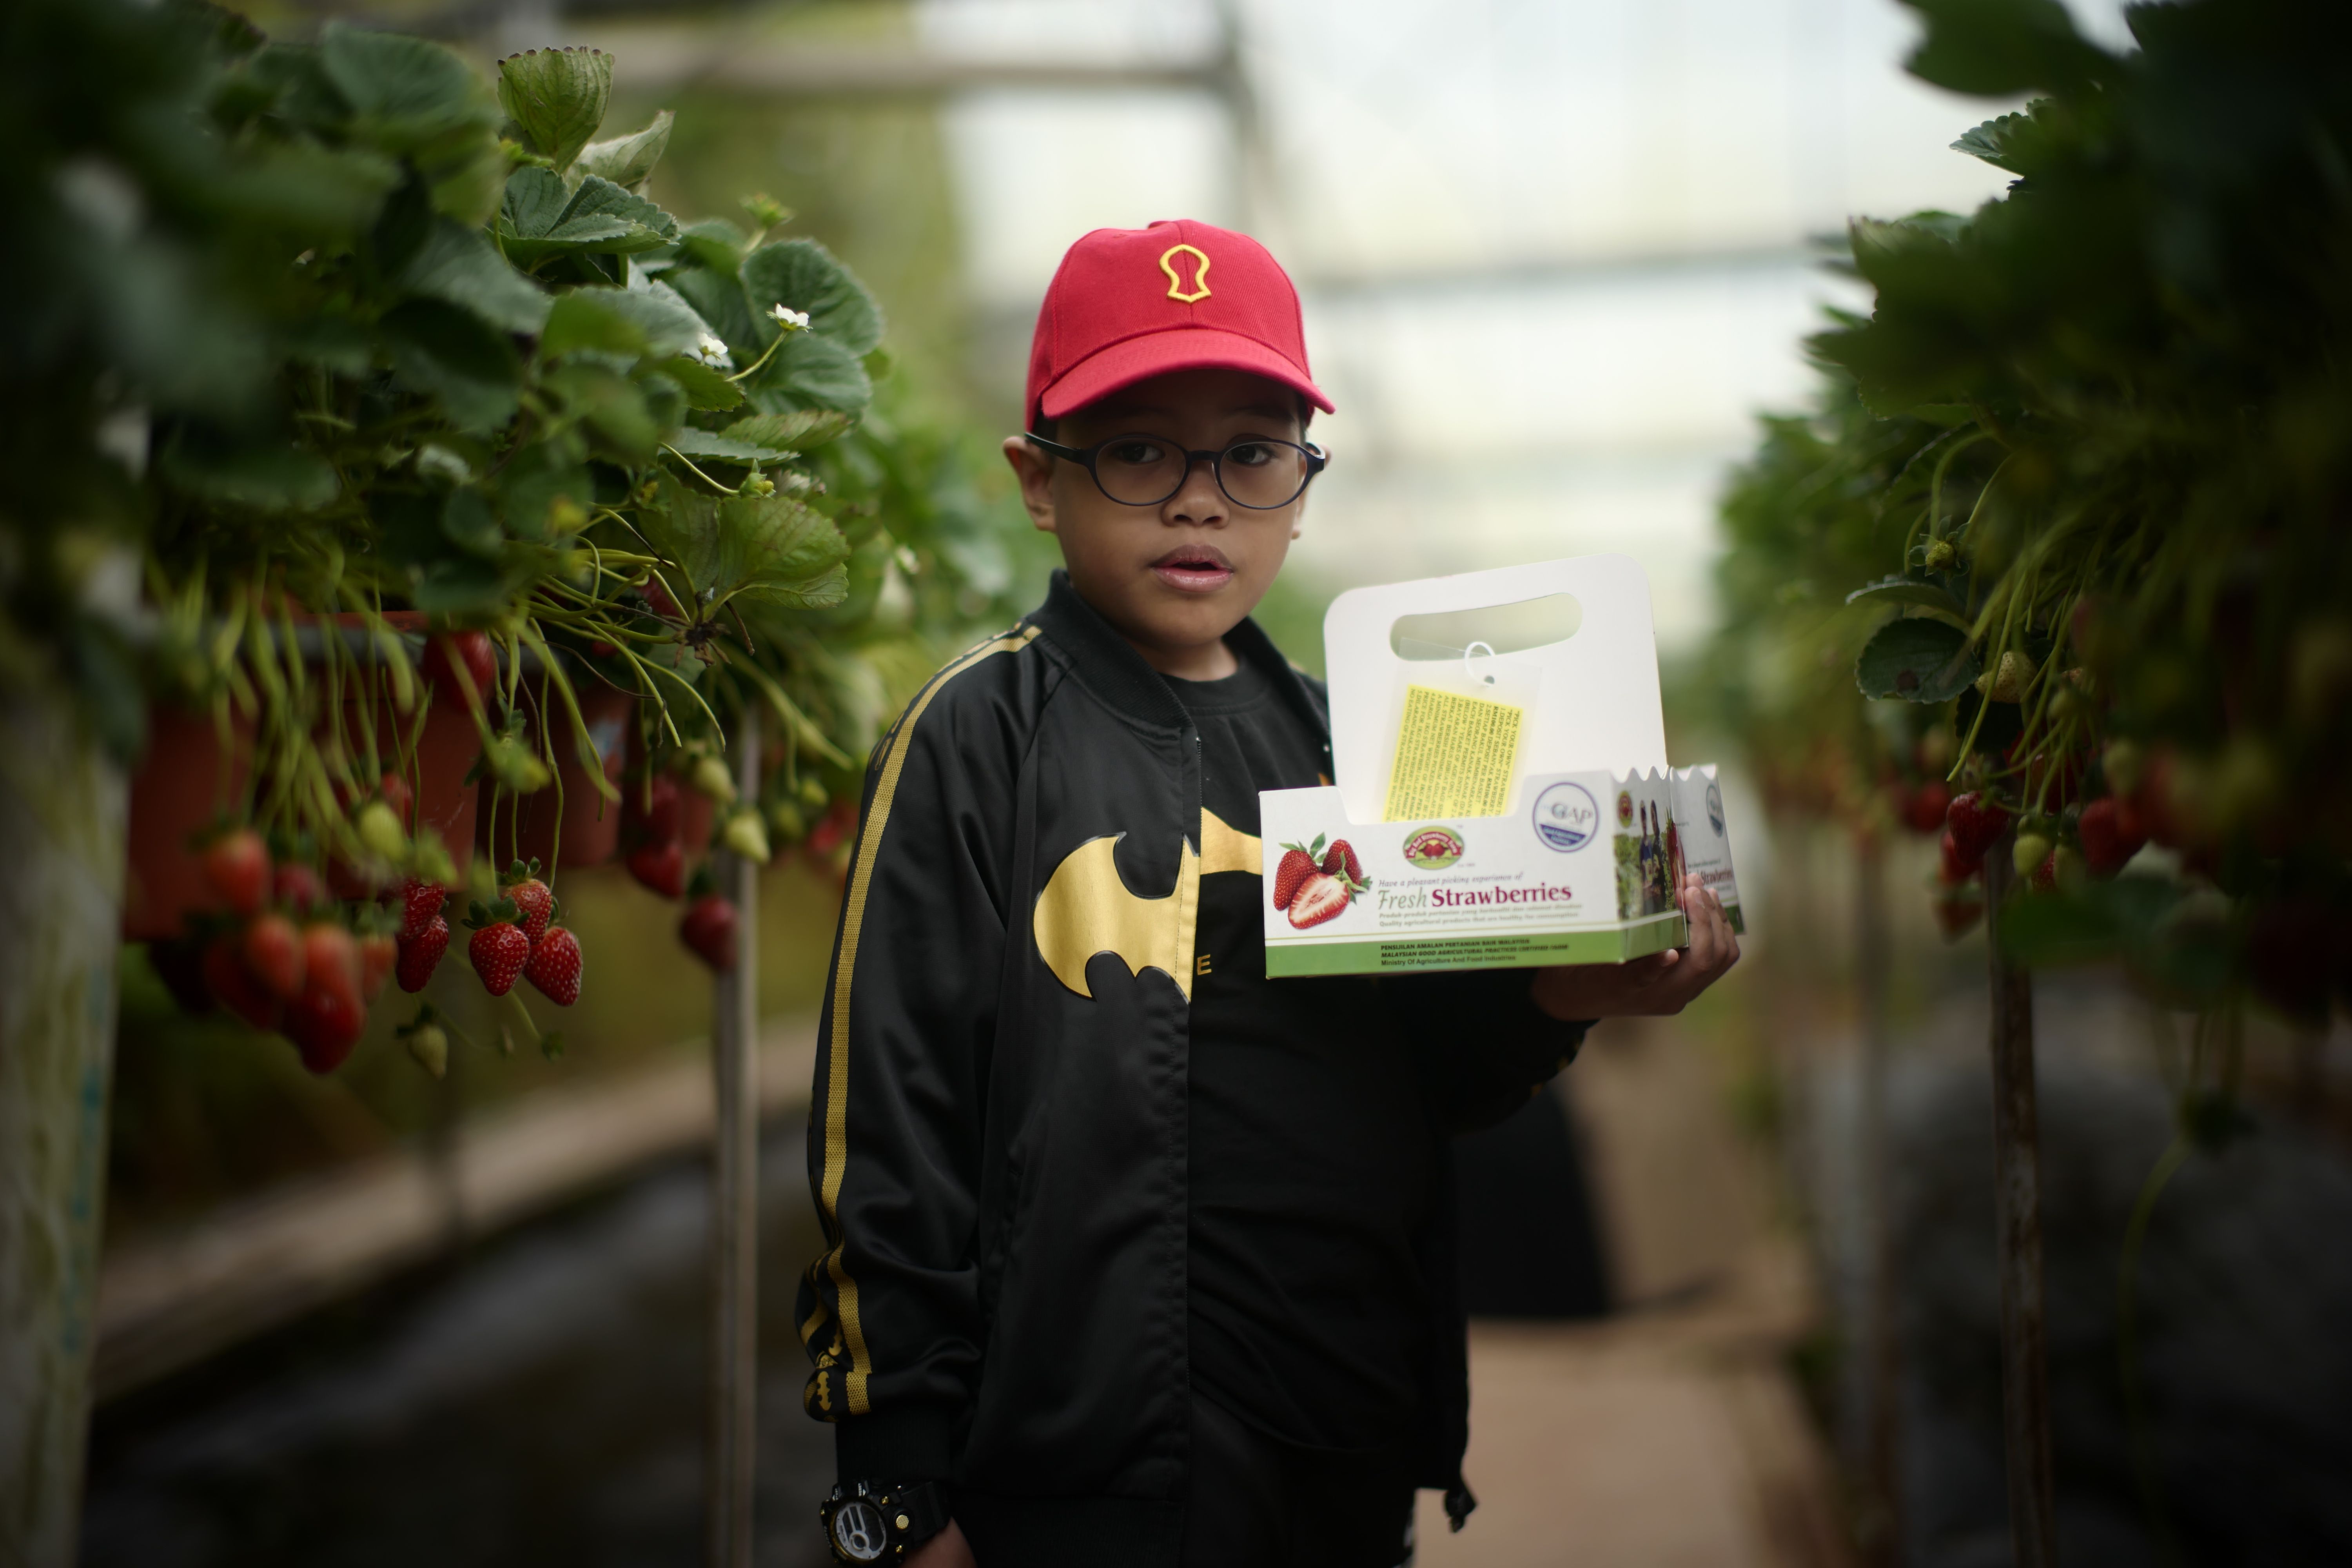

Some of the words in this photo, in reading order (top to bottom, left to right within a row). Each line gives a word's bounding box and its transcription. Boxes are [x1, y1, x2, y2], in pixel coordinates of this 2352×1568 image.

[1405, 699, 1414, 723] EATING
[1410, 690, 1423, 728] 5.DILARANG
[1421, 691, 1429, 709] PRICE
[1426, 692, 1436, 720] 4.HARGA
[1447, 697, 1457, 722] BERKAT
[1461, 699, 1470, 725] (BELOW
[1469, 701, 1477, 719] EACH
[1431, 700, 1441, 731] MINIMUM
[1452, 698, 1463, 735] 3.BAYARAN
[1481, 704, 1491, 731] 2.SETIAP
[1488, 706, 1499, 735] RM100.00
[1495, 707, 1506, 739] 1.DEPOSIT
[1406, 730, 1415, 754] MAKAN
[1433, 709, 1447, 759] STRAWBERRIES
[1442, 724, 1451, 747] BERSIH
[1456, 731, 1465, 753] YEARS
[1464, 720, 1474, 746] BASKET
[1471, 718, 1481, 749] SEORANG
[1477, 732, 1486, 755] BAKUL
[1393, 734, 1407, 783] STRAWBERRIES
[1407, 739, 1420, 783] STRAWBERRY
[1416, 735, 1428, 773] STRAWBERI
[1423, 747, 1433, 771] WEIGHT
[1447, 737, 1456, 759] HARUS
[1459, 747, 1468, 775] PERMITS
[1483, 736, 1493, 763] DEPOSIT
[1488, 740, 1499, 776] SEBANYAK
[1398, 755, 1410, 792] STRAWBERI
[1428, 760, 1437, 784] PICKED
[1436, 749, 1446, 779] MINIMUM
[1443, 760, 1452, 784] DIBUAT
[1450, 764, 1458, 780] AGE)
[1461, 750, 1475, 799] KANAK-KANAK
[1388, 785, 1397, 806] WHILE
[1412, 775, 1420, 795] IALAH
[1424, 785, 1432, 803] MUST
[1430, 781, 1440, 809] ADALAH
[1454, 776, 1463, 797] ENTRY
[1467, 757, 1481, 809] MEMBENARKAN
[1482, 777, 1492, 807] RM100.00
[1488, 768, 1501, 813] STRAWBERRY
[1497, 770, 1508, 808] STRAWBERI
[1393, 794, 1403, 818] SAMBIL
[1407, 878, 1439, 888] pleasant
[1441, 876, 1470, 886] picking
[1514, 871, 1523, 881] of
[1378, 887, 1427, 909] Fresh
[1432, 882, 1572, 907] Strawberries
